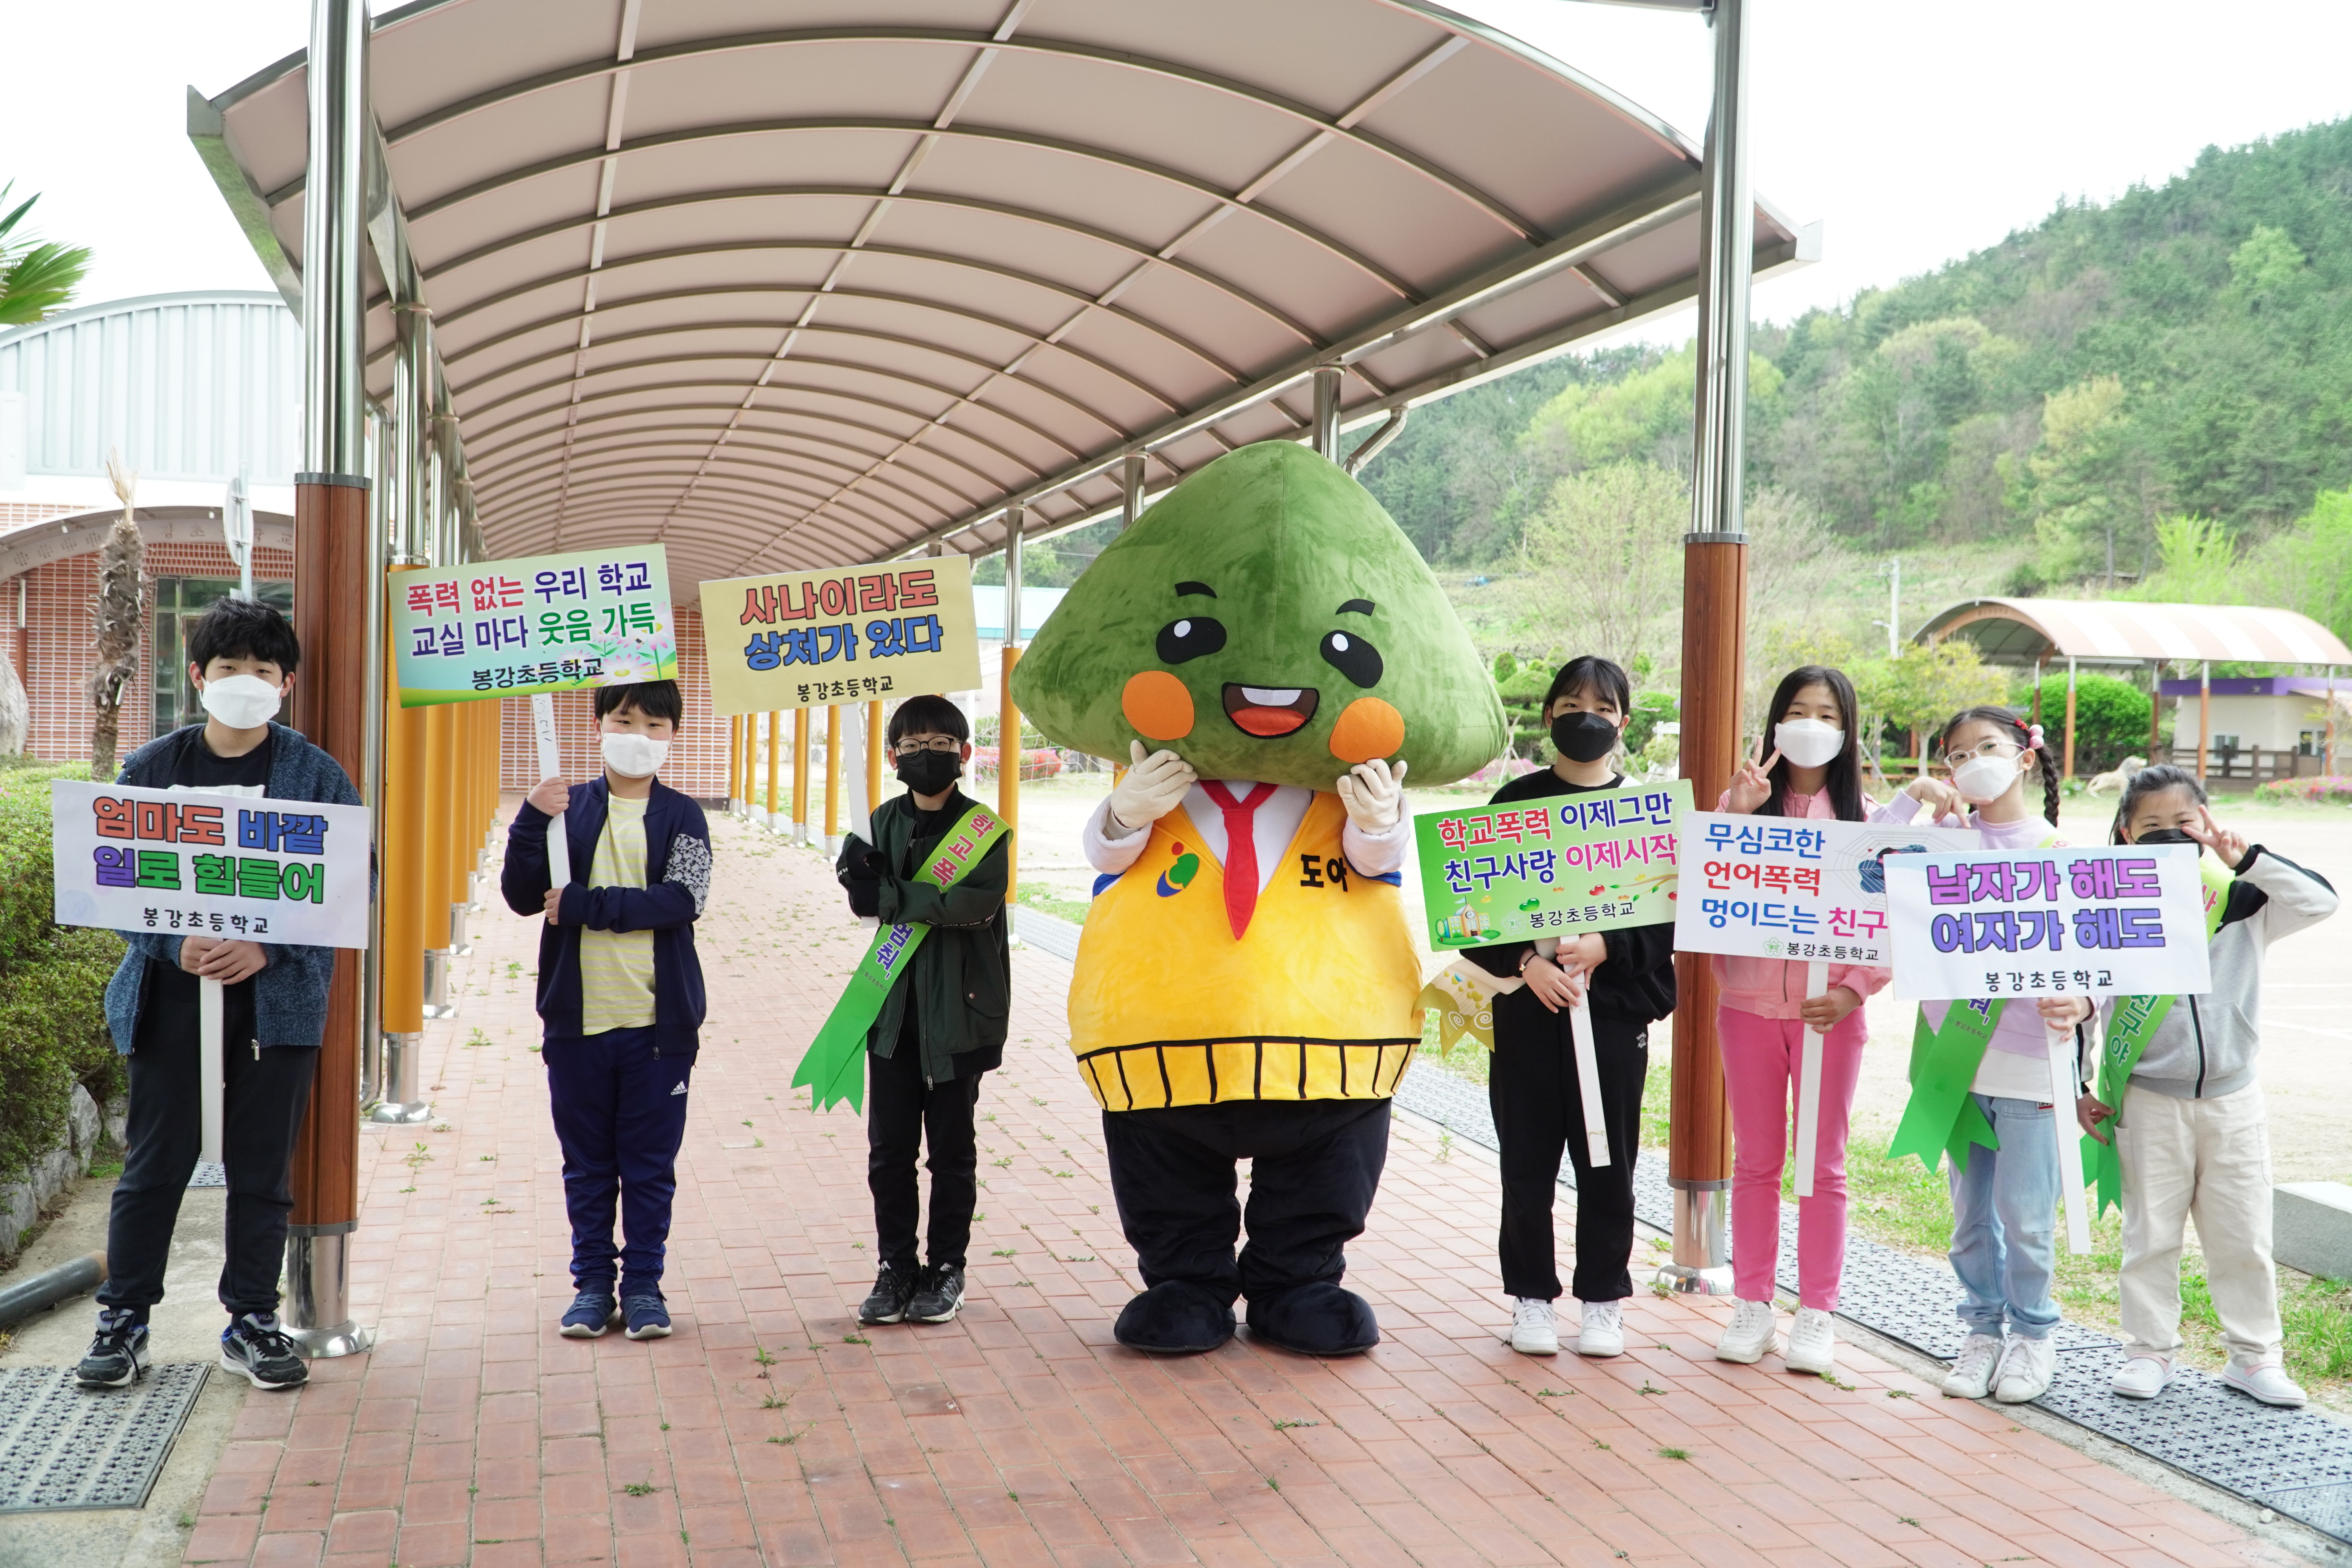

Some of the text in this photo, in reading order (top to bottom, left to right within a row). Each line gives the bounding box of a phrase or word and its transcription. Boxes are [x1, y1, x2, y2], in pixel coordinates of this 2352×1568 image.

[407, 562, 652, 617] 폭력 없는 우리 학교
[740, 569, 938, 625] 사나이라도
[412, 601, 655, 657] 교실 마다 웃음 가득
[744, 614, 943, 671] 상처가 있다
[471, 657, 604, 691] 봉강초등학교
[797, 675, 893, 702] 봉강초등학교
[93, 796, 328, 855] 엄마도 바깥
[1437, 791, 1673, 852] 학교폭력 이제그만
[1705, 824, 1826, 858] 무심코한
[93, 846, 325, 904] 일로 힘들어
[1445, 833, 1678, 894] 친구사랑 이제시작
[1704, 861, 1820, 897] 언어폭력
[1927, 860, 2061, 905] 남자가
[2069, 858, 2162, 900] 해도
[143, 907, 269, 934] 봉강초등학교
[1530, 902, 1635, 928] 봉강초등학교
[1702, 899, 1888, 939] 멍이드는 친구
[1931, 908, 2166, 953] 여자가 해도
[1787, 942, 1879, 961] 봉강초등학교
[1985, 970, 2113, 992] 봉강초등학교
